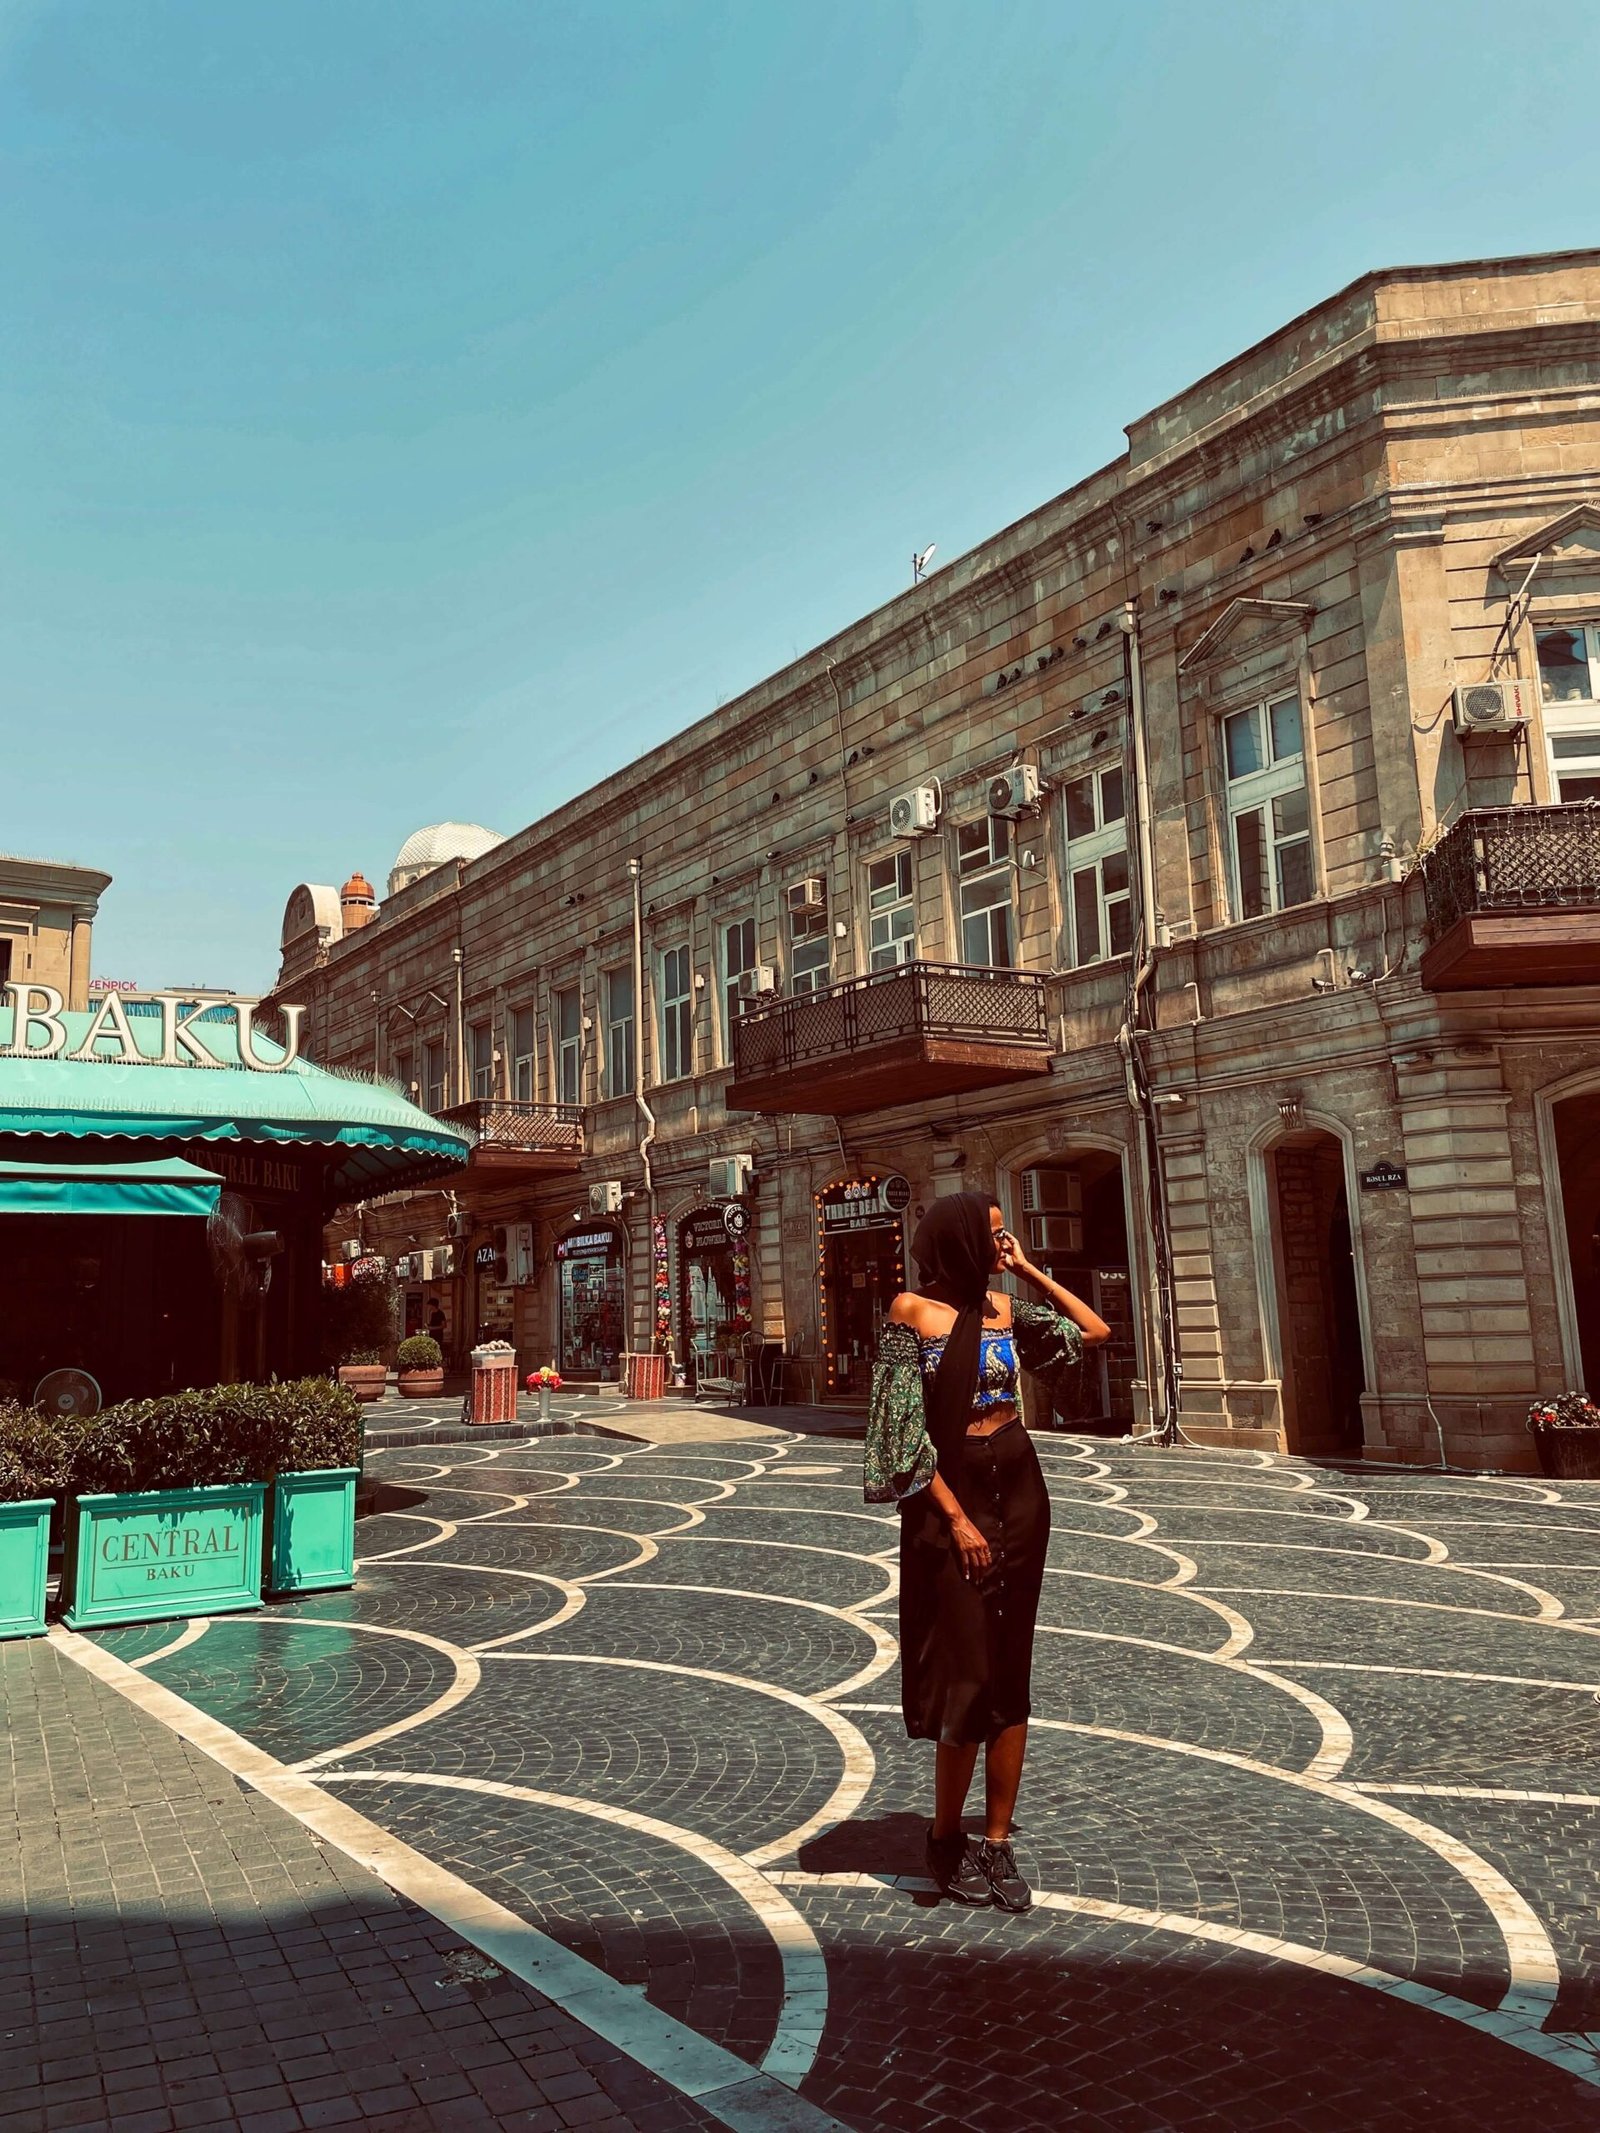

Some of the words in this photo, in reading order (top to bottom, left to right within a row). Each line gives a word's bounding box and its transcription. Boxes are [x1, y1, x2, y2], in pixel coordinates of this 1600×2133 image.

[1514, 685, 1522, 716] SHIVAKI
[0, 981, 306, 1073] BAKU
[263, 1159, 302, 1192] BAKU
[825, 1201, 859, 1221] THREE
[102, 1525, 239, 1563] CENTRAL
[147, 1564, 195, 1581] BAKU
